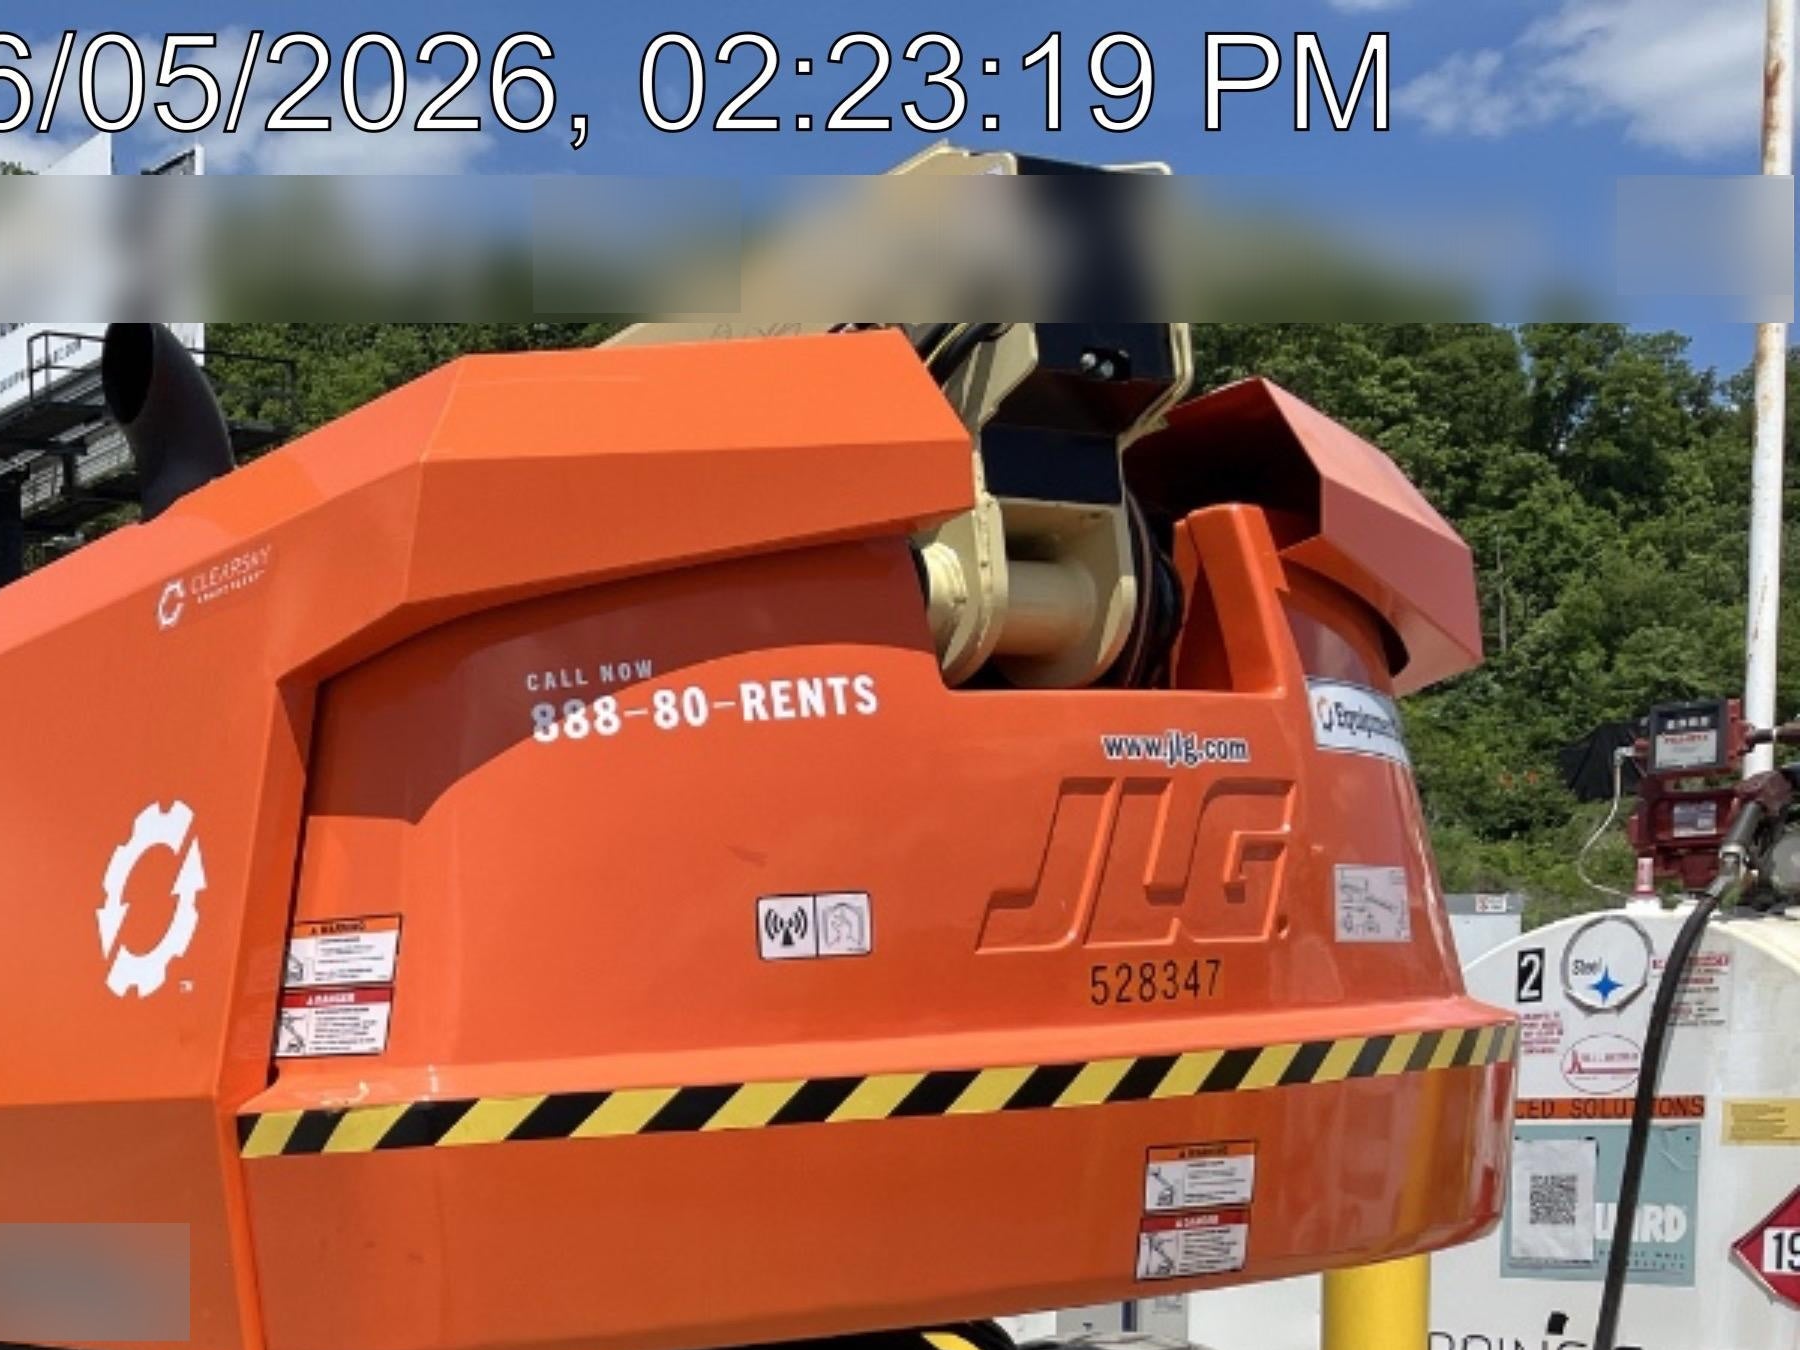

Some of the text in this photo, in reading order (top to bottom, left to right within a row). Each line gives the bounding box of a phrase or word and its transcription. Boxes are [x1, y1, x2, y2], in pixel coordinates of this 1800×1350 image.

[527, 658, 654, 692] CALL NOW
[529, 674, 878, 742] 888-80-RENTS
[1102, 730, 1250, 767] www.jlg.com
[975, 776, 1297, 955] JLG
[1091, 958, 1222, 1005] 528347
[1520, 953, 1542, 999] 2
[1570, 1095, 1705, 1119] SOLUONS
